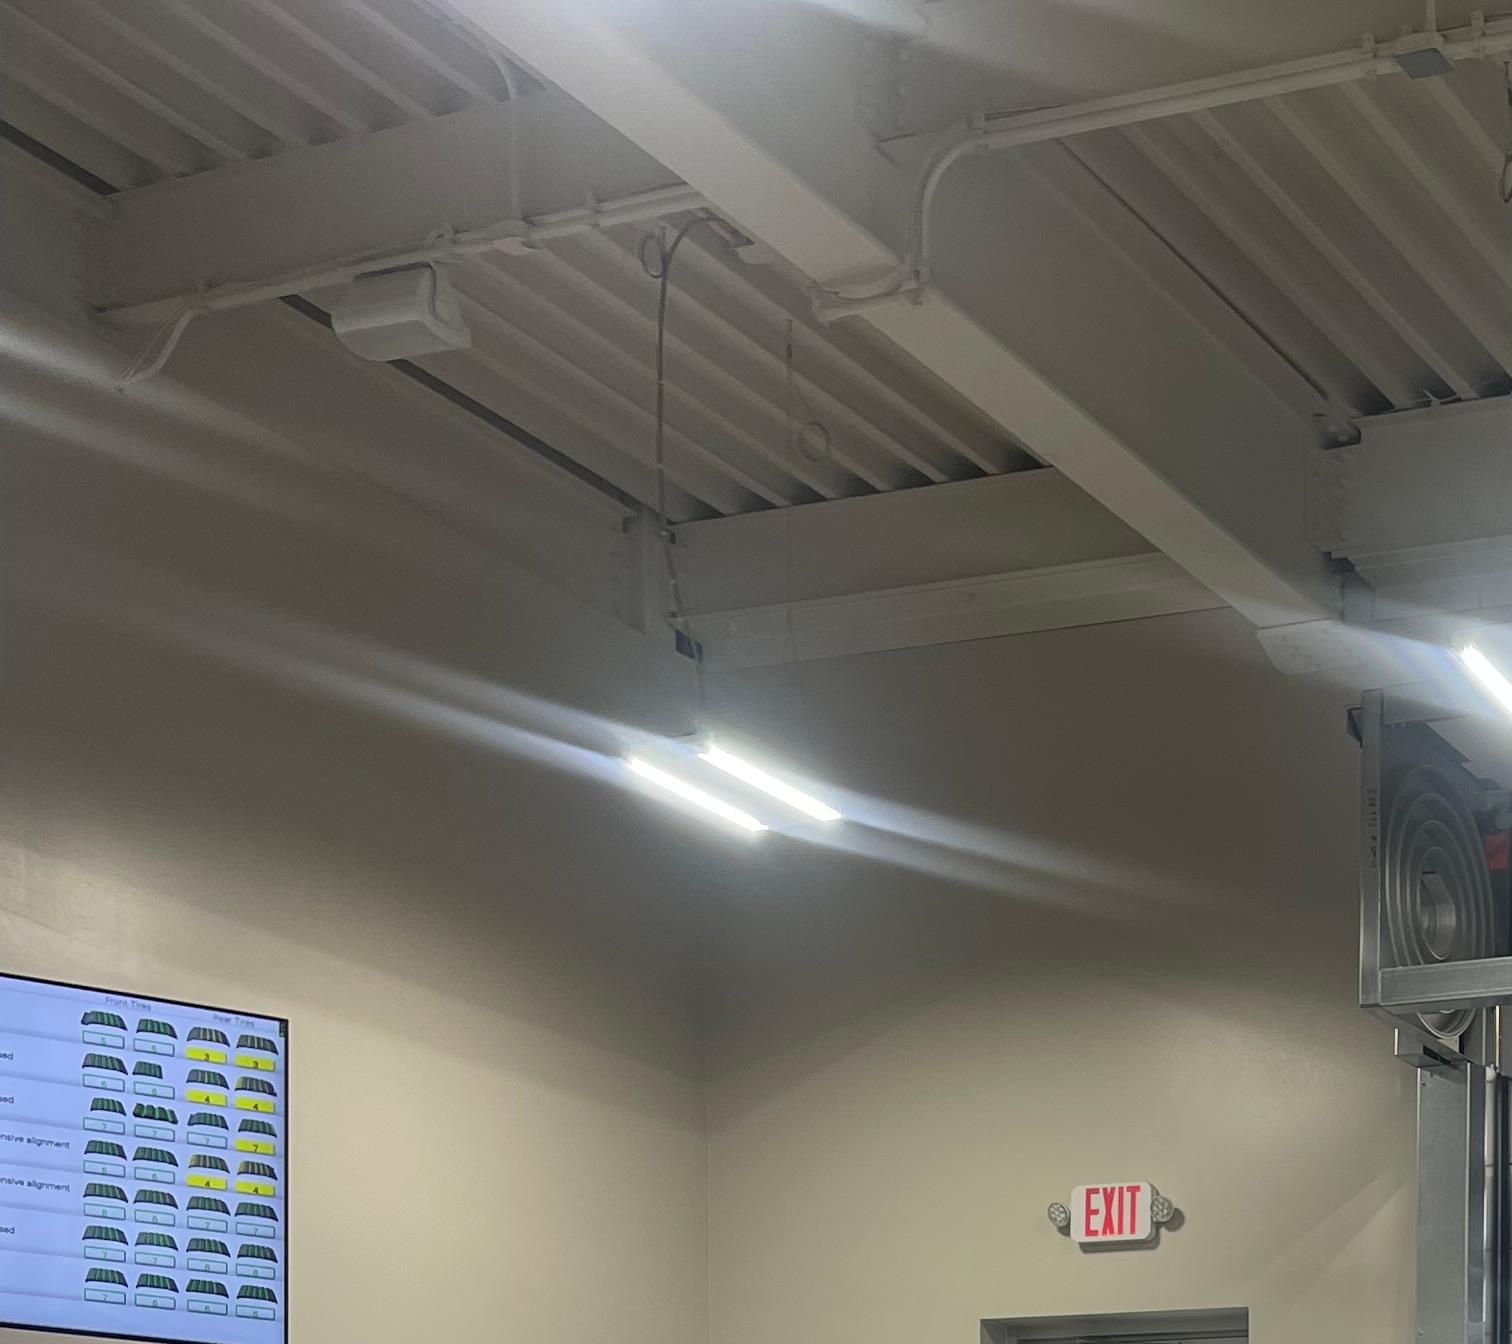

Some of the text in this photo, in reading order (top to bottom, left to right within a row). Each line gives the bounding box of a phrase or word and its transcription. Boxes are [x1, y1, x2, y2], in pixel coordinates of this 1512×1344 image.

[26, 1137, 70, 1149] alignment
[26, 1180, 70, 1193] alignment
[1084, 1185, 1141, 1238] EXIT
